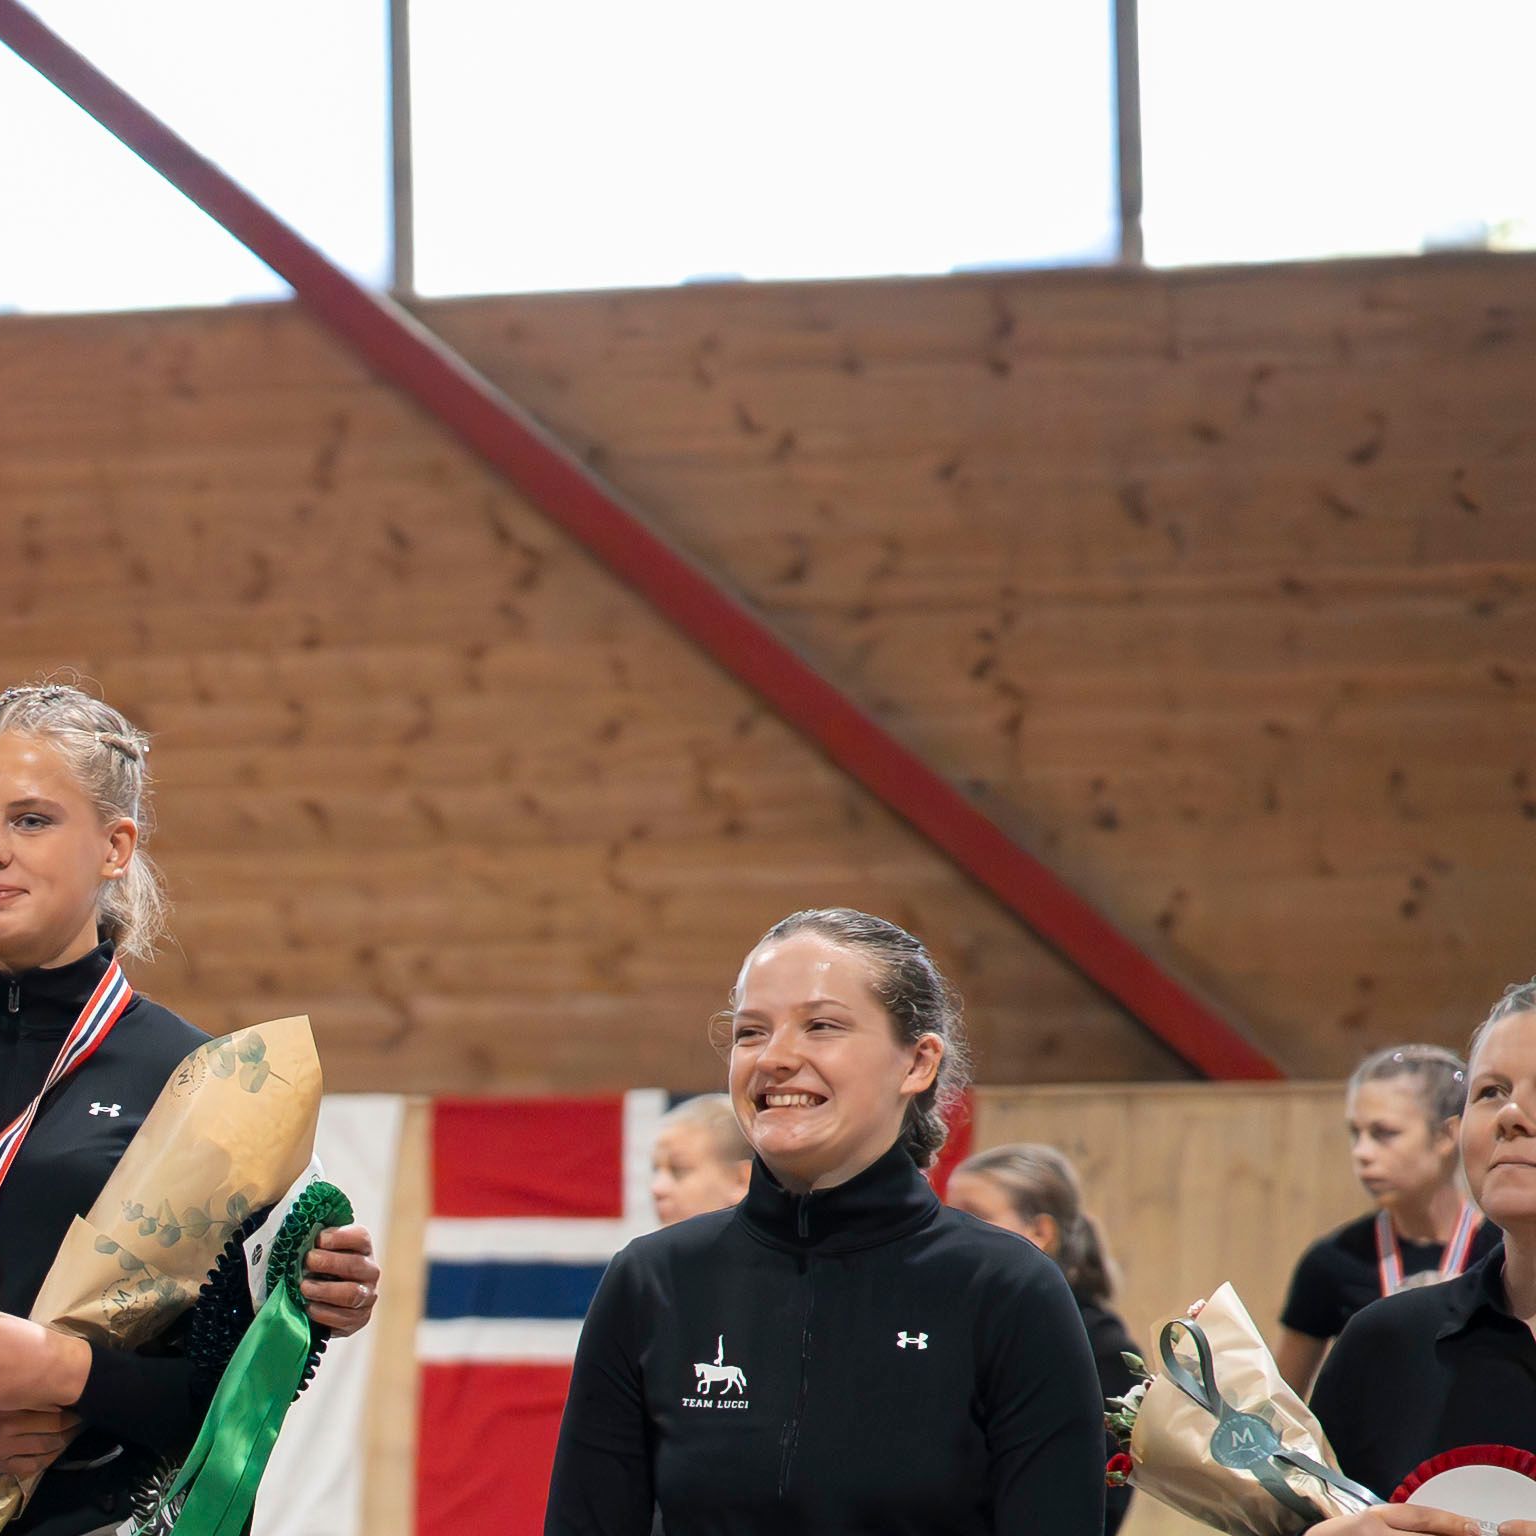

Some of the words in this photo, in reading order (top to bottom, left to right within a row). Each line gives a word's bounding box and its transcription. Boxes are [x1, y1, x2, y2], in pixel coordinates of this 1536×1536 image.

[682, 1398, 713, 1408] TEAM
[717, 1400, 749, 1409] LUCCI
[1231, 1427, 1255, 1448] M
